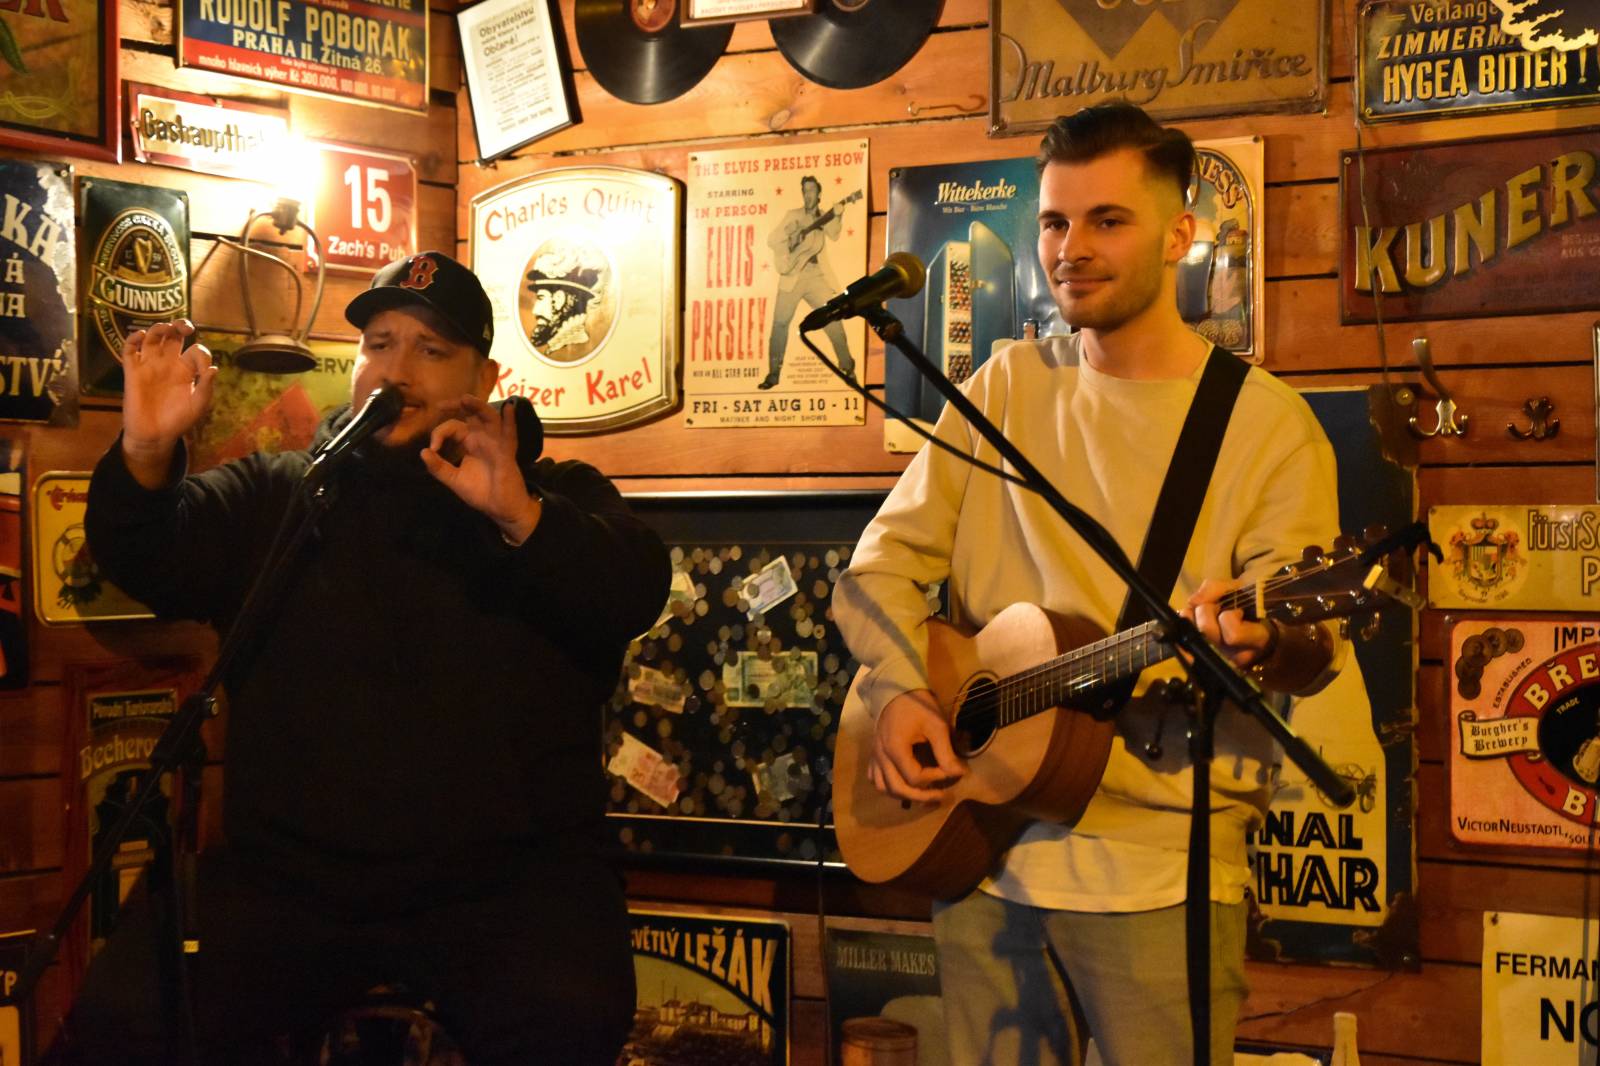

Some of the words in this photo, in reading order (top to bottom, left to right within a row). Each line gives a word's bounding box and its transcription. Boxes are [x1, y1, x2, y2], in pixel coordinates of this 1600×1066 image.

[201, 0, 291, 35] RUDOLF
[305, 6, 411, 60] POBORÁK
[233, 29, 296, 57] PRAHA
[321, 42, 361, 71] Žitná
[1000, 32, 1168, 104] Malburg
[1383, 57, 1468, 103] HYGEA
[1478, 51, 1567, 93] BITTER
[695, 163, 719, 176] THE
[724, 160, 759, 174] ELVIS
[764, 156, 820, 171] PRESLEY
[825, 152, 864, 167] SHOW
[344, 164, 392, 233] 15
[708, 188, 754, 198] STARRING
[937, 178, 1017, 203] Wittekerke
[484, 193, 567, 241] Charles
[695, 208, 710, 219] IN
[716, 204, 768, 217] PERSON
[328, 235, 375, 258] Zach's
[379, 243, 406, 261] Pub
[706, 224, 754, 288] ELVIS
[400, 256, 439, 289] B
[101, 276, 182, 311] GUINNESS
[691, 298, 767, 361] PRESLEY
[495, 363, 565, 406] Keizer
[586, 357, 652, 406] Karel
[693, 402, 717, 413] FRI
[734, 400, 762, 413] SAT
[768, 399, 801, 412] AUG
[809, 399, 825, 411] 10
[844, 398, 858, 410] 11
[1556, 697, 1580, 715] TRADE
[1471, 719, 1529, 738] Burgher's
[1473, 736, 1528, 751] Brewery
[80, 734, 160, 778] Bechero
[1458, 816, 1497, 832] VICTOR
[1255, 852, 1380, 911] HAR
[684, 927, 778, 1017] LEŽÁK
[836, 946, 887, 972] MILLER
[891, 951, 936, 976] MAKES
